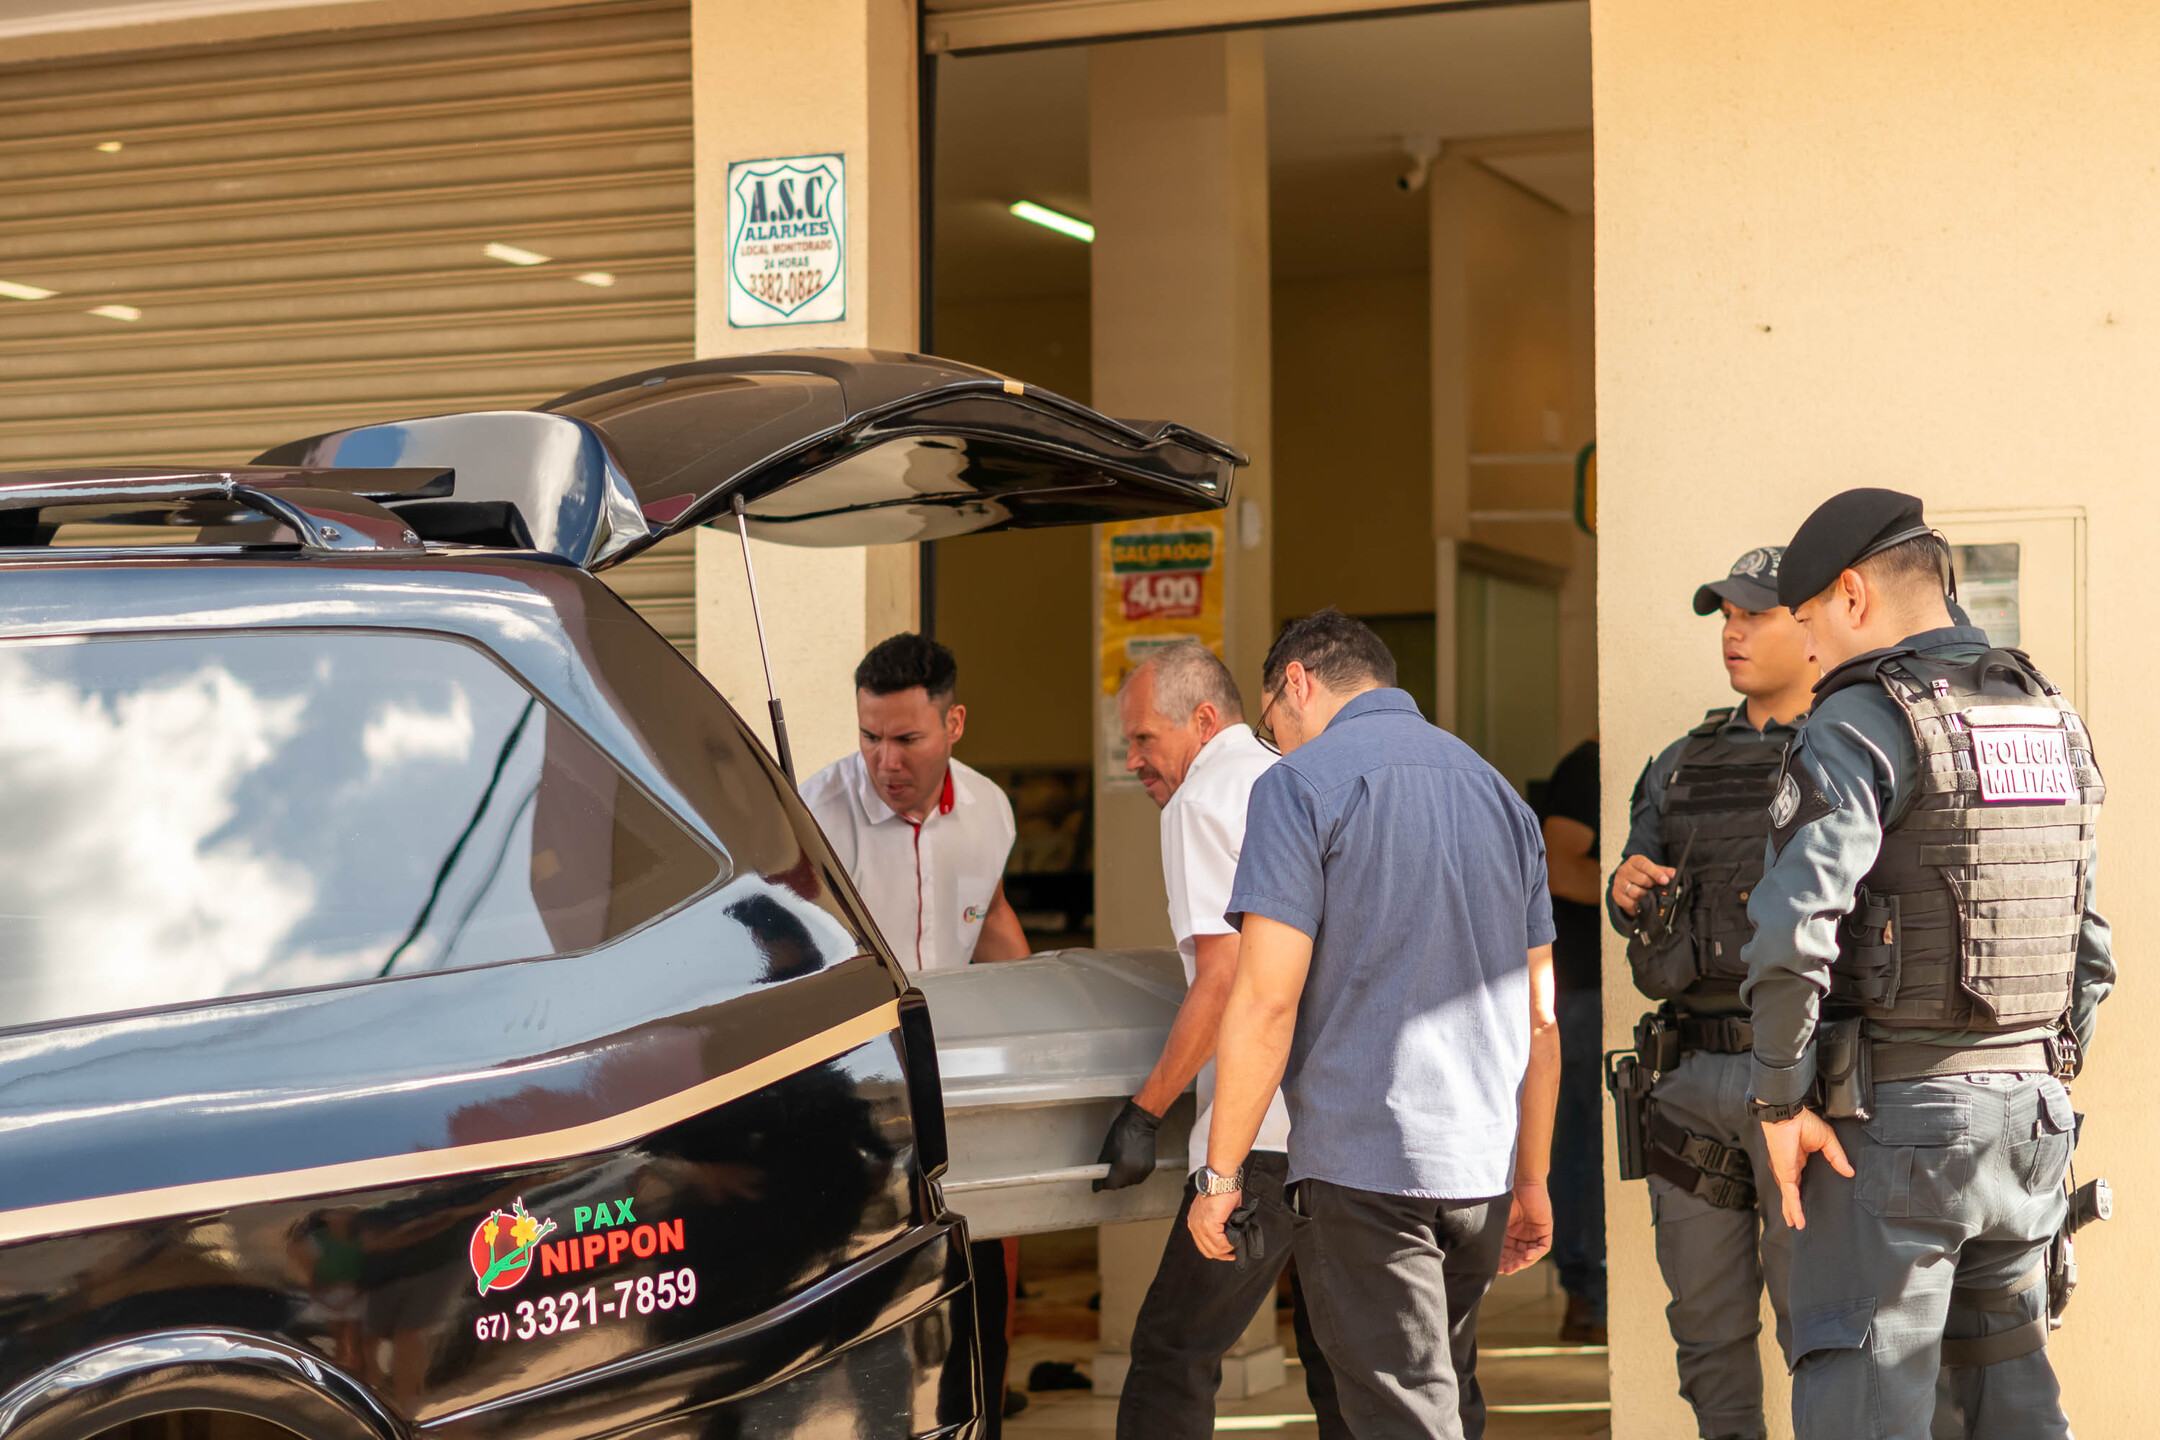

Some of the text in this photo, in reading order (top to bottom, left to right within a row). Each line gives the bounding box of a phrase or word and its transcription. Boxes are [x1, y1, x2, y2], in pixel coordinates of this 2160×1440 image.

[750, 176, 822, 223] A.S.C
[745, 221, 829, 241] ALARMES
[741, 240, 832, 256] LOCAL MONITORADO
[764, 256, 809, 270] 24 HORAS
[1113, 543, 1210, 562] SALGADOS
[1127, 576, 1198, 610] 4,00
[1980, 733, 2062, 765] POLÍCIA
[1986, 768, 2067, 794] MILITAR
[574, 1197, 637, 1233] PAX
[540, 1218, 685, 1277] NIPPON
[515, 1267, 697, 1340] 3321-7859
